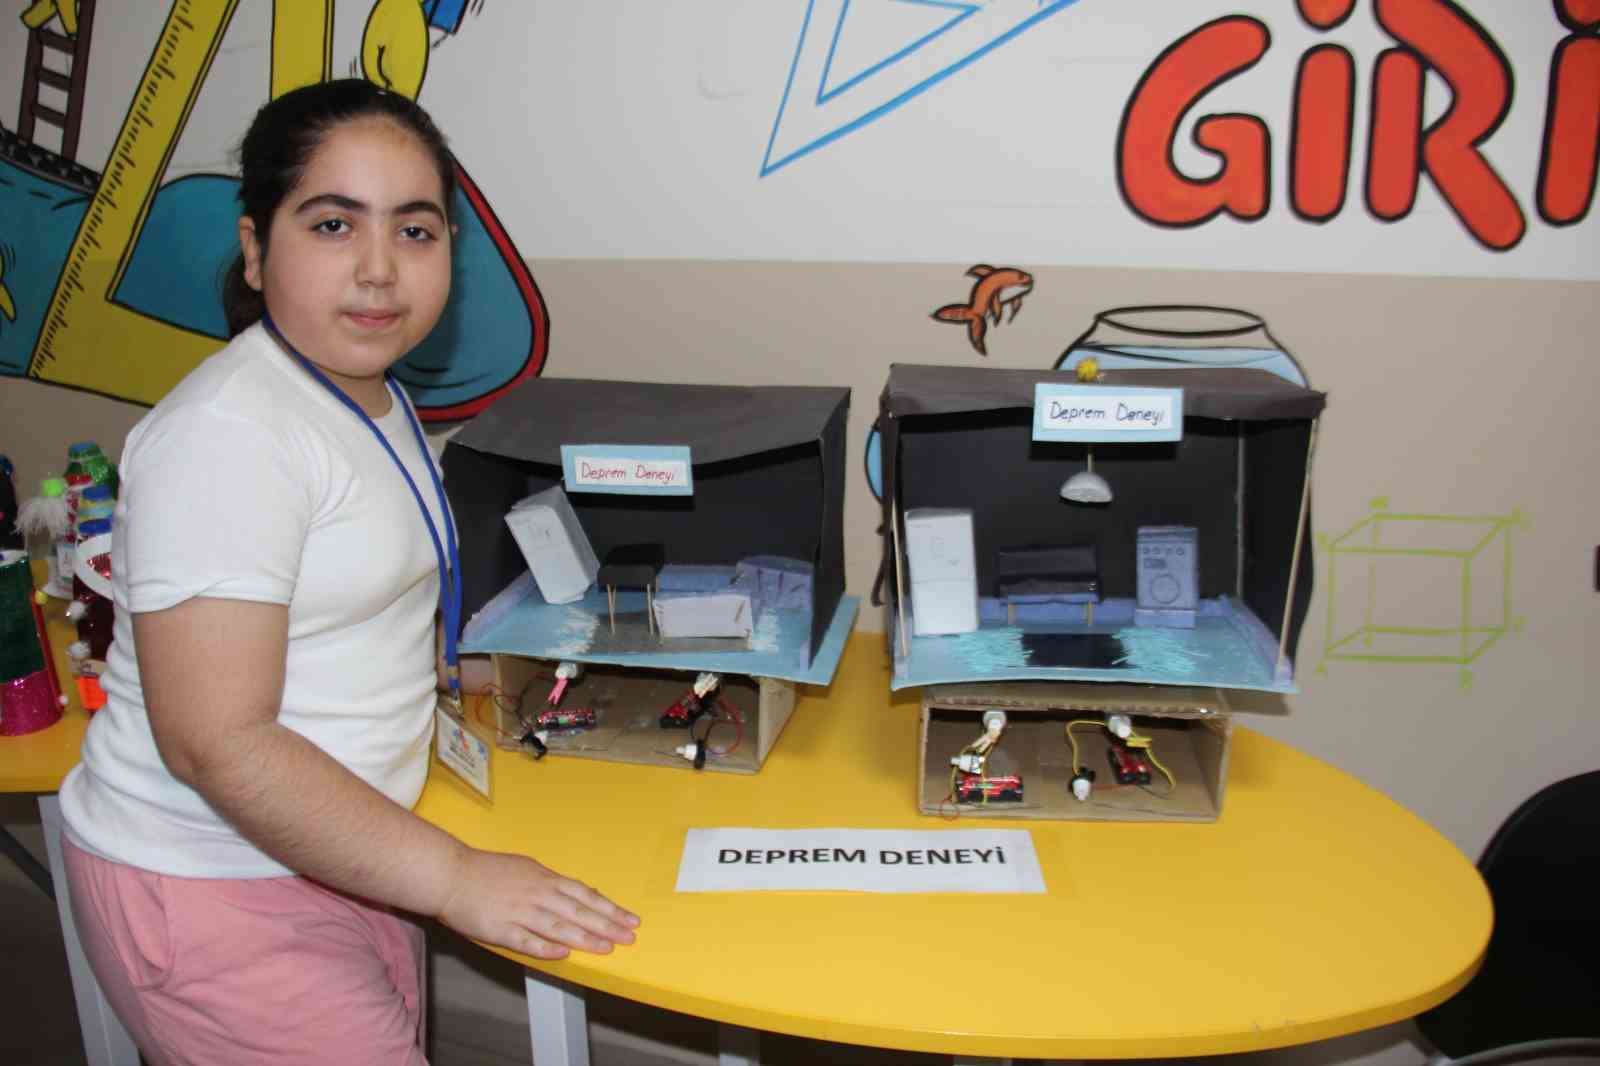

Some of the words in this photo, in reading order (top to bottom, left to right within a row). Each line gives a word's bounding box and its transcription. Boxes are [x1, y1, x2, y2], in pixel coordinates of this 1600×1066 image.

[1050, 401, 1105, 423] Deprem
[581, 461, 626, 481] Deprem
[717, 847, 867, 865] DEPREM
